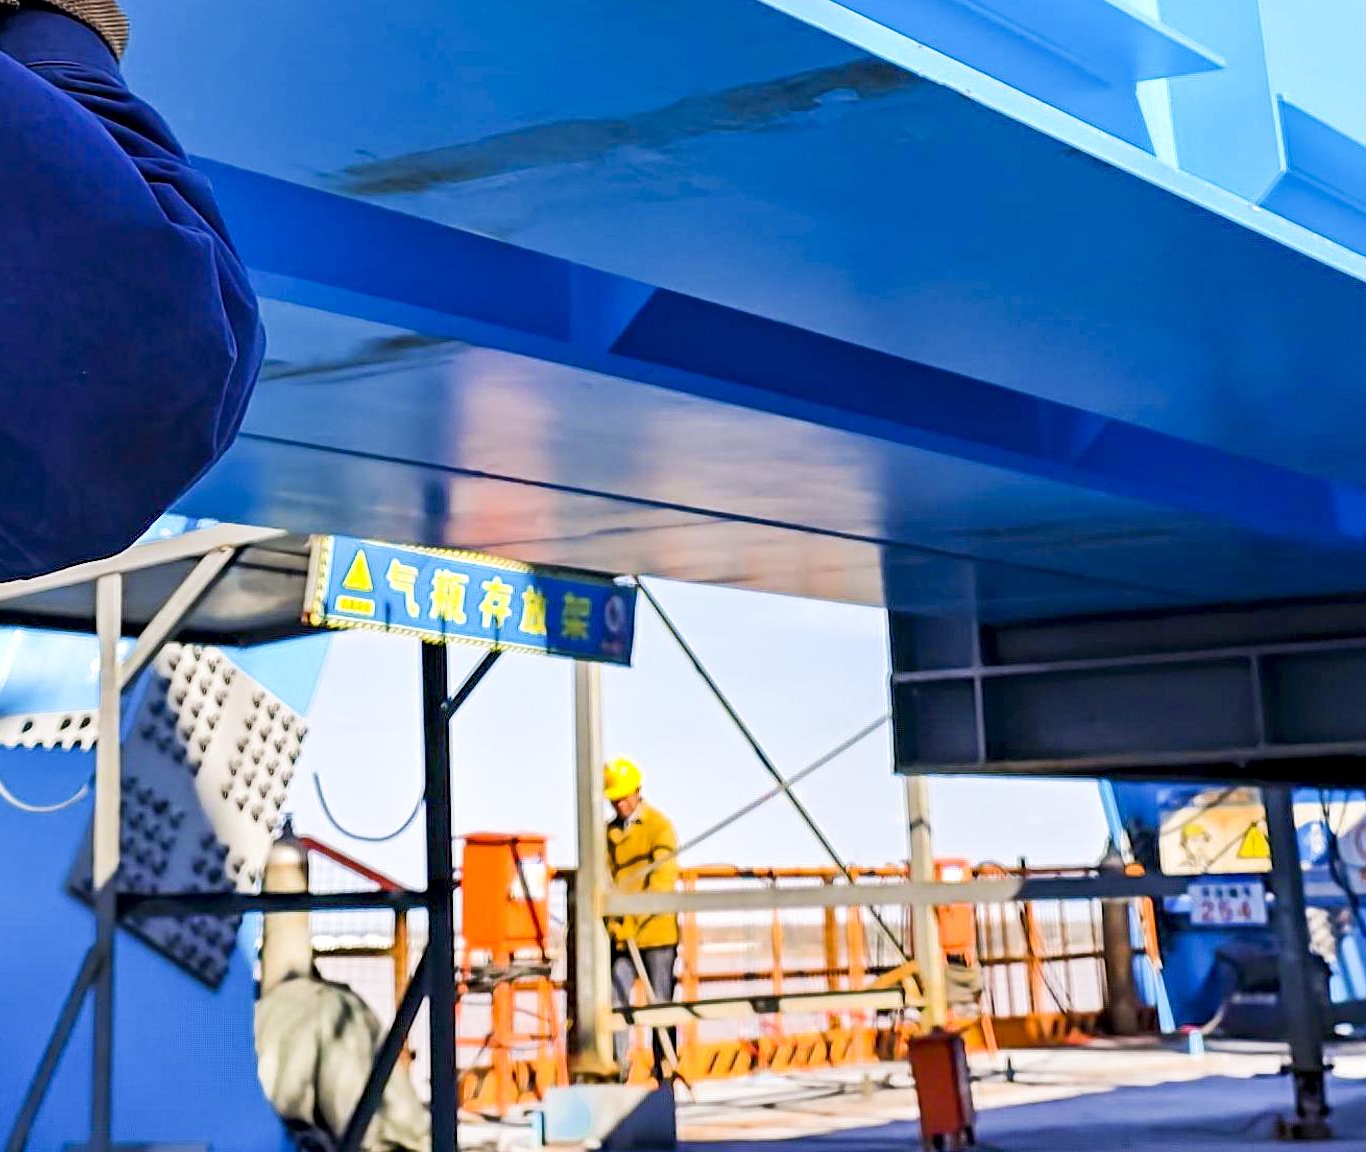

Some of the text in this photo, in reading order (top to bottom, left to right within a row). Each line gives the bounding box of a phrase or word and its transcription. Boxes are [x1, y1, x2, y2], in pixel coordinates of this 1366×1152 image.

[385, 557, 593, 641] 气瓶存放架
